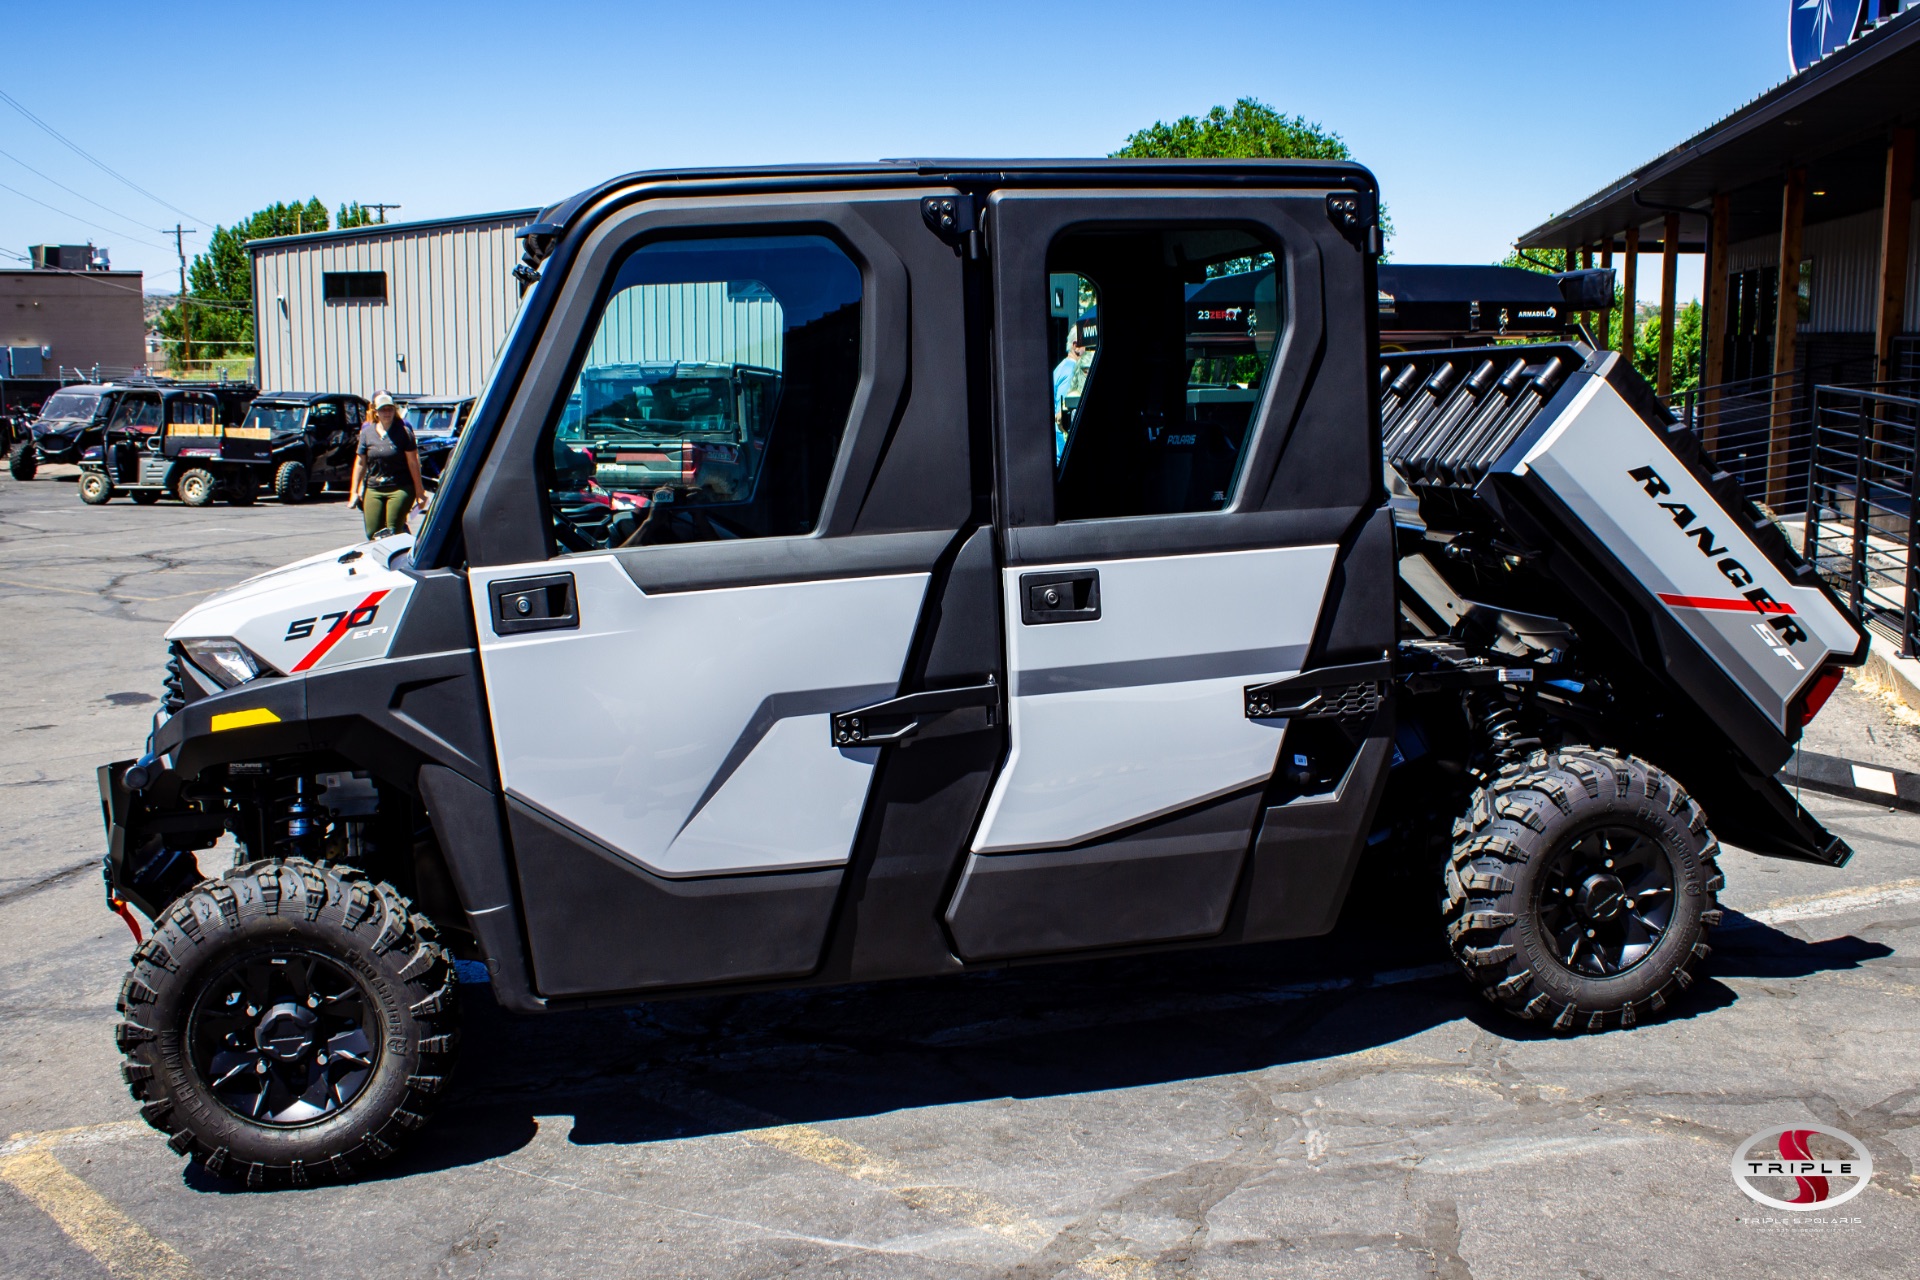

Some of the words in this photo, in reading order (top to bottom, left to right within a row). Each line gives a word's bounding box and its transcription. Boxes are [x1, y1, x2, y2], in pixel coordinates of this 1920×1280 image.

[1167, 435, 1196, 444] POLARIS
[1627, 465, 1808, 646] RANGER
[284, 605, 380, 641] 570
[352, 626, 389, 640] EFI
[1751, 624, 1805, 670] SP
[161, 1028, 240, 1140] X-TERRAIN
